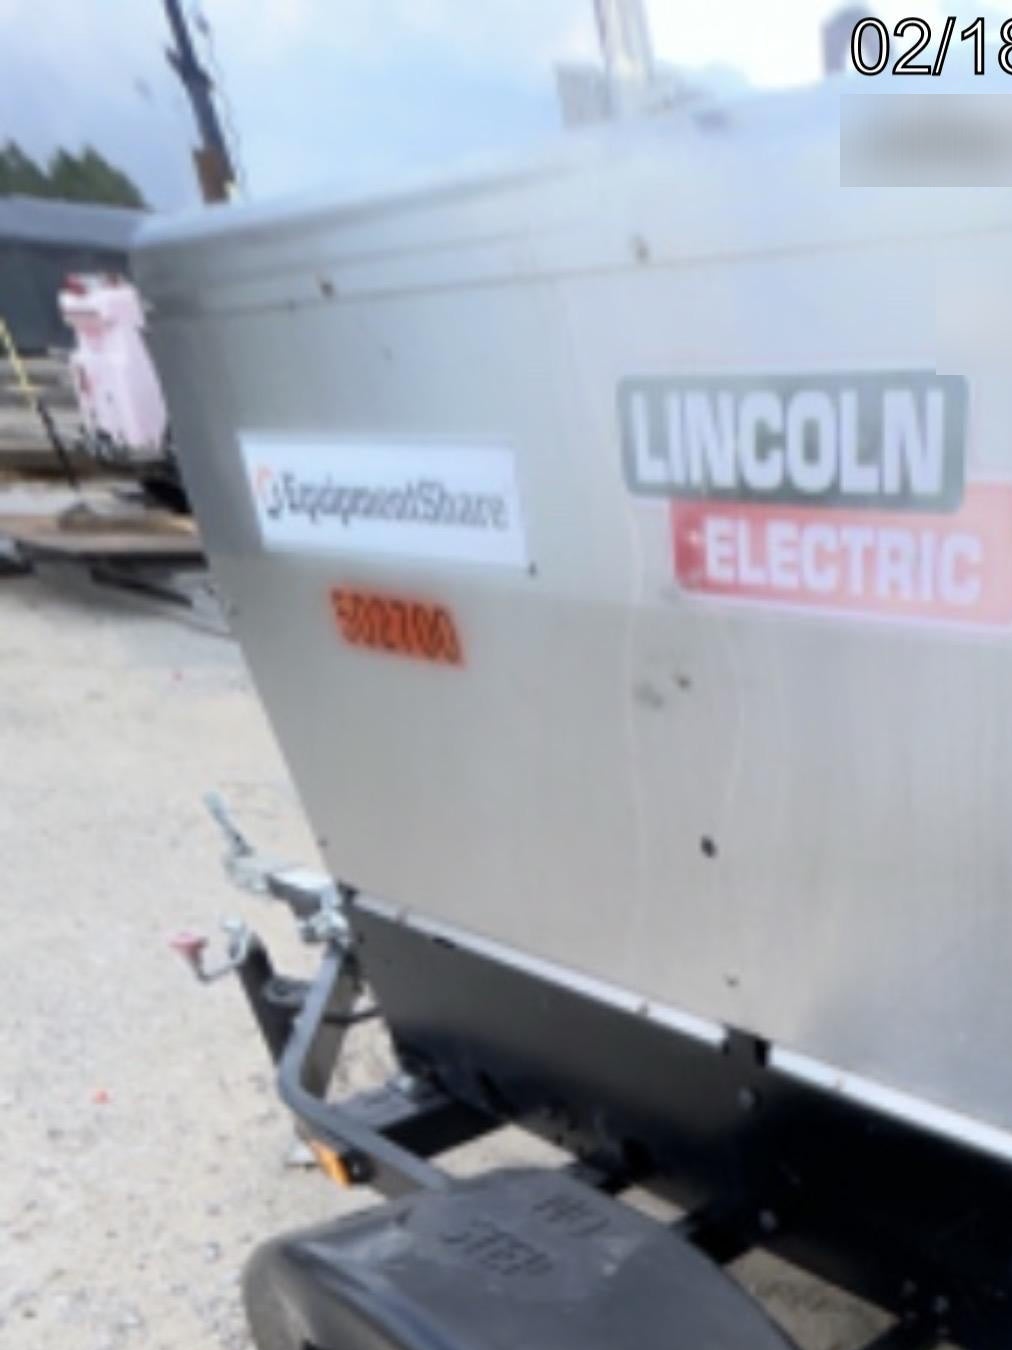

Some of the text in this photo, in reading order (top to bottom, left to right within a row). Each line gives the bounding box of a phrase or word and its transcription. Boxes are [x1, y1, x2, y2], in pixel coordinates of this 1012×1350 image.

[630, 388, 945, 496] LINCOLN
[281, 470, 510, 532] EquipmentShare
[703, 517, 983, 607] ELECTRIC
